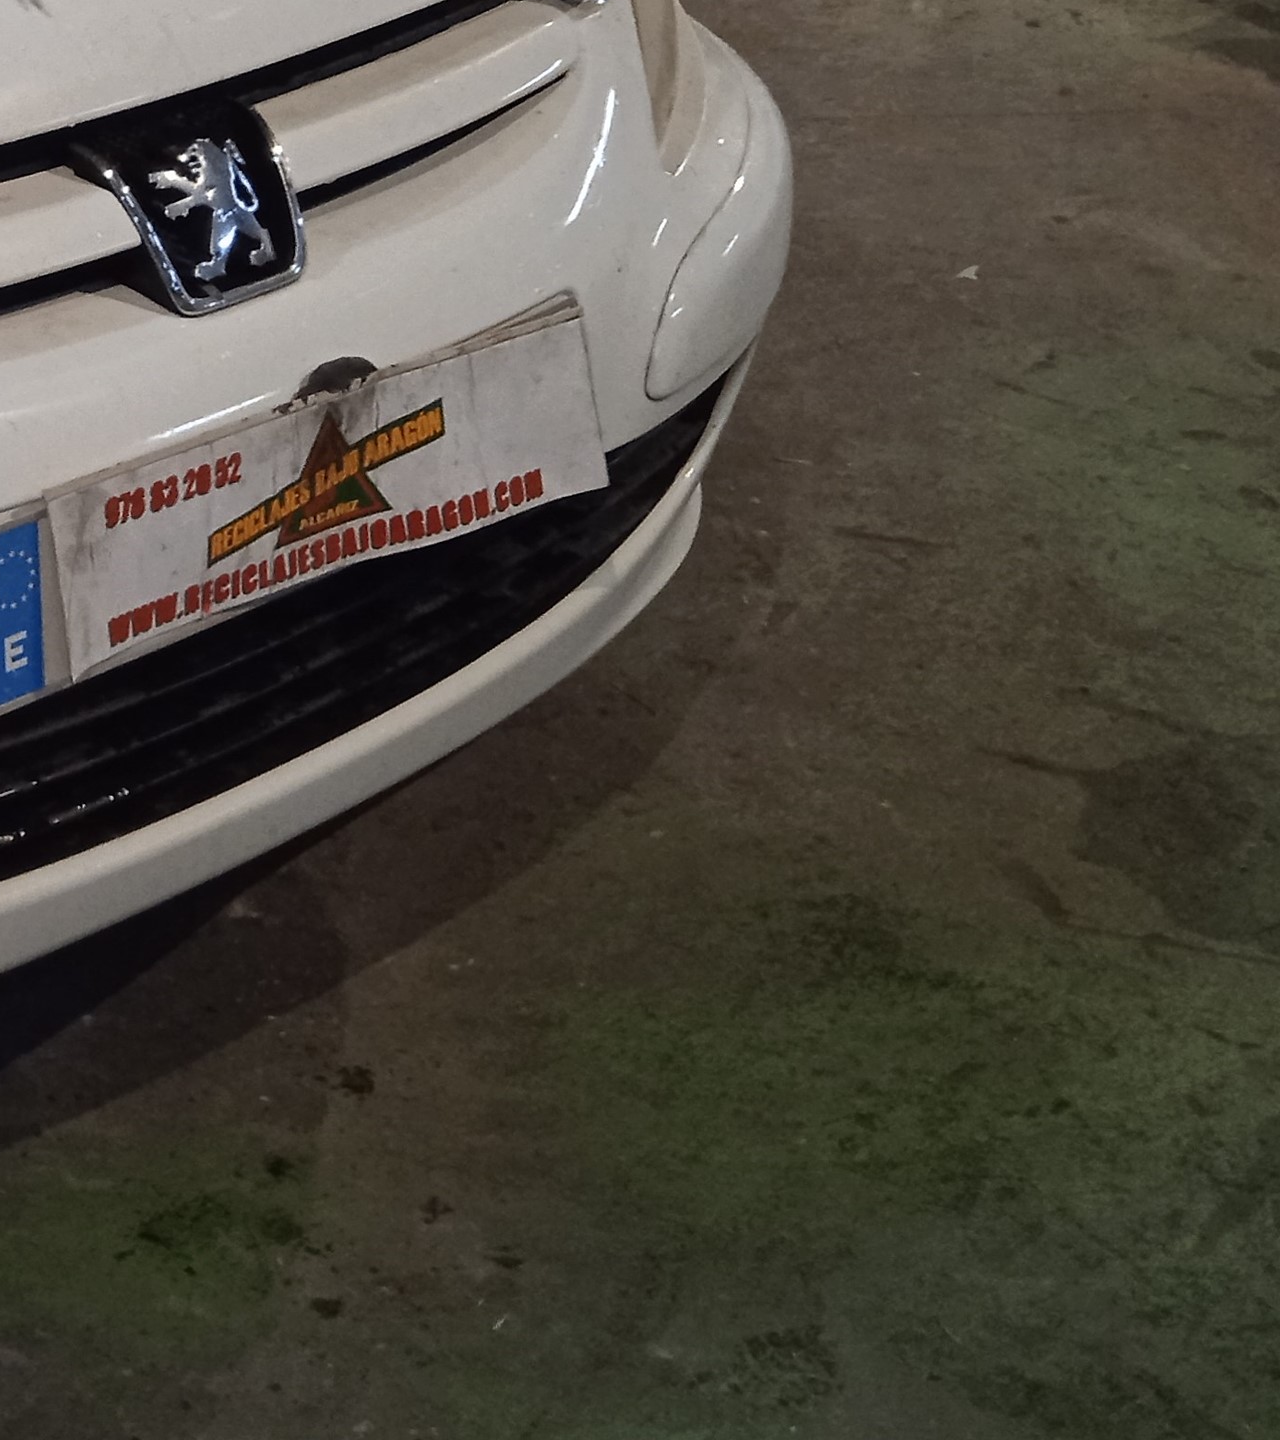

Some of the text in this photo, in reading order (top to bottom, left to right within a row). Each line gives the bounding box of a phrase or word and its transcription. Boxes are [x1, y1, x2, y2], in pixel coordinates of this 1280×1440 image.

[210, 478, 310, 560] RECICLAJES
[315, 449, 361, 496] BAJO
[215, 452, 242, 488] 52
[107, 468, 544, 648] WWW.RECICLAJESBAJOARAGON.COM
[4, 630, 28, 673] E
